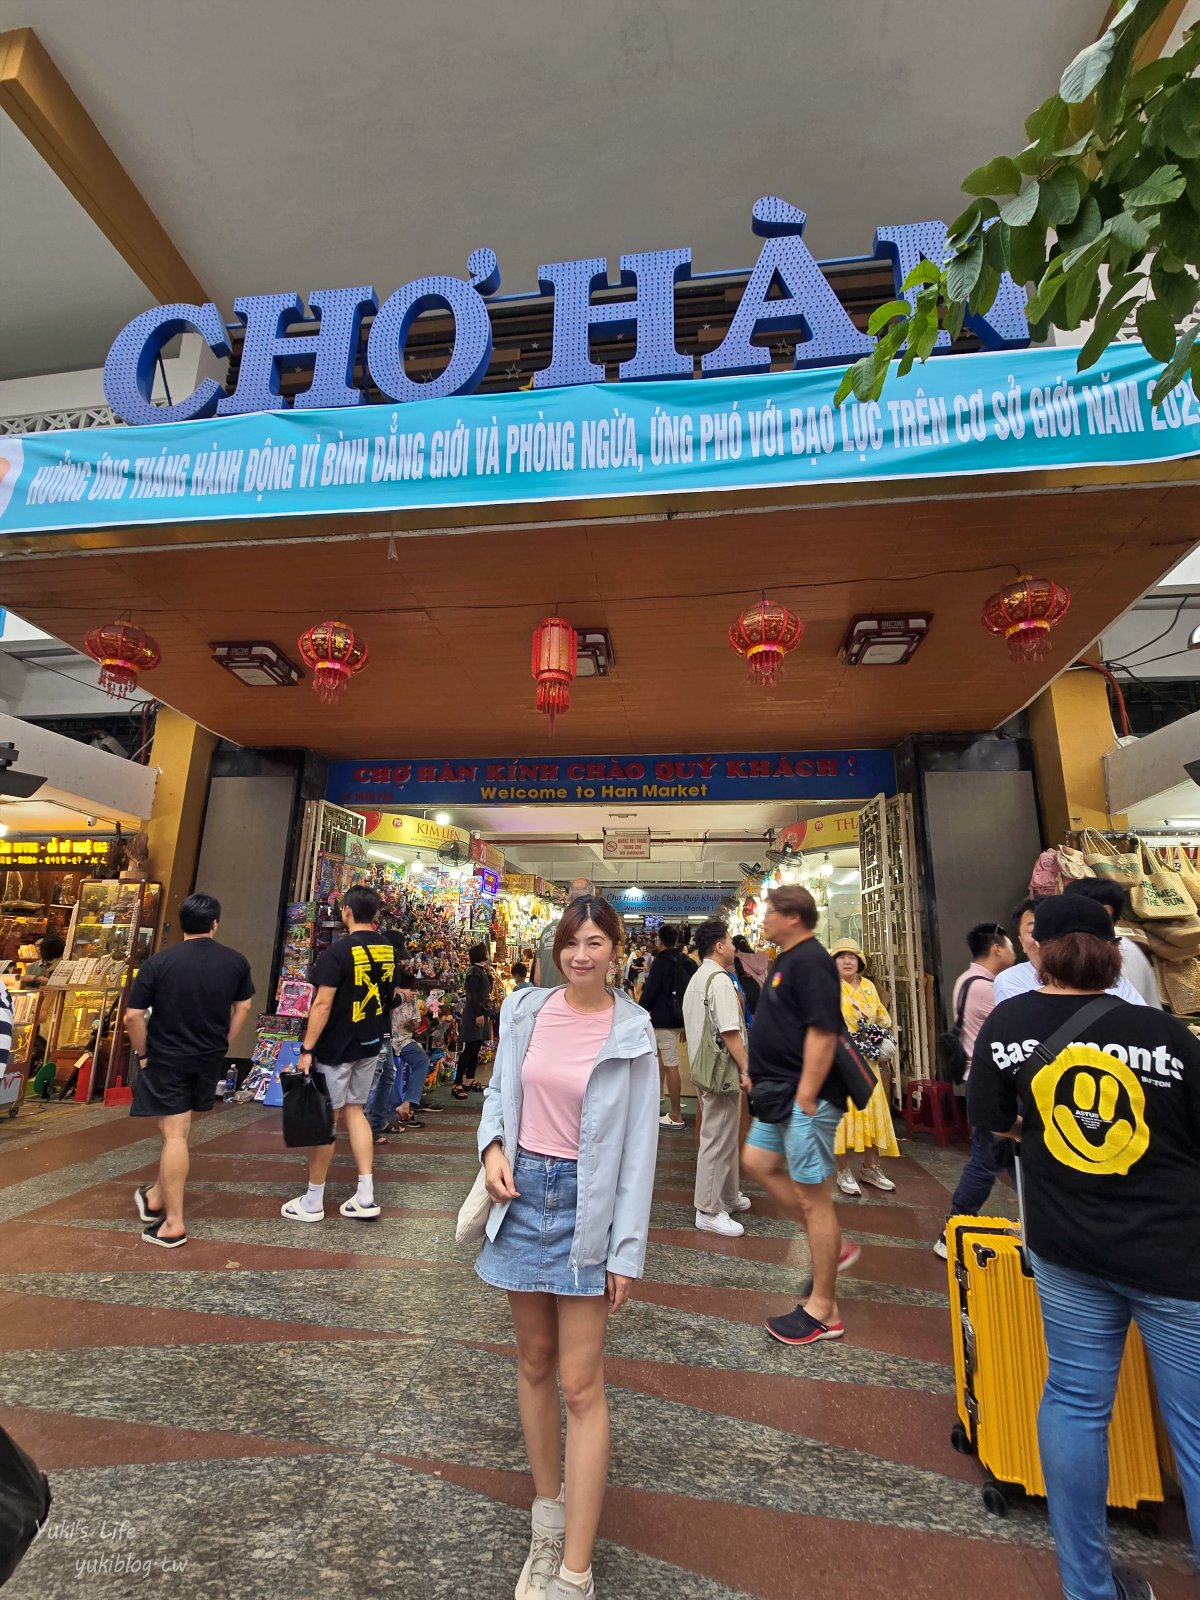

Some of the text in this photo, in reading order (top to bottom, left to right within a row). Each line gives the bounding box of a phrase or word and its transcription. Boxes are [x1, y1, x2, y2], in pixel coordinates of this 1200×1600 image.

[26, 372, 1200, 505] HƯỞNG ỨNG THÁNG HÀNH ĐỘNG VÌ BÌNH ĐẲNG GIỚI VÀ PHÒNG NGỪA, ỨNG PHÓ VỚI BẠO LỰC TRÊN CƠ SỞ GIỚI NĂM 202
[354, 765, 412, 789] CHỢ
[417, 761, 478, 784] HÀN
[486, 760, 559, 783] KÍNH
[567, 758, 646, 781] CHÀO
[655, 755, 718, 782] QUÝ
[726, 754, 838, 779] KHÁCH
[480, 784, 707, 800] Welcome to Han Market
[417, 823, 439, 836] KIM
[624, 904, 656, 912] Welcome
[685, 904, 709, 912] Market
[1163, 896, 1185, 907] SUN
